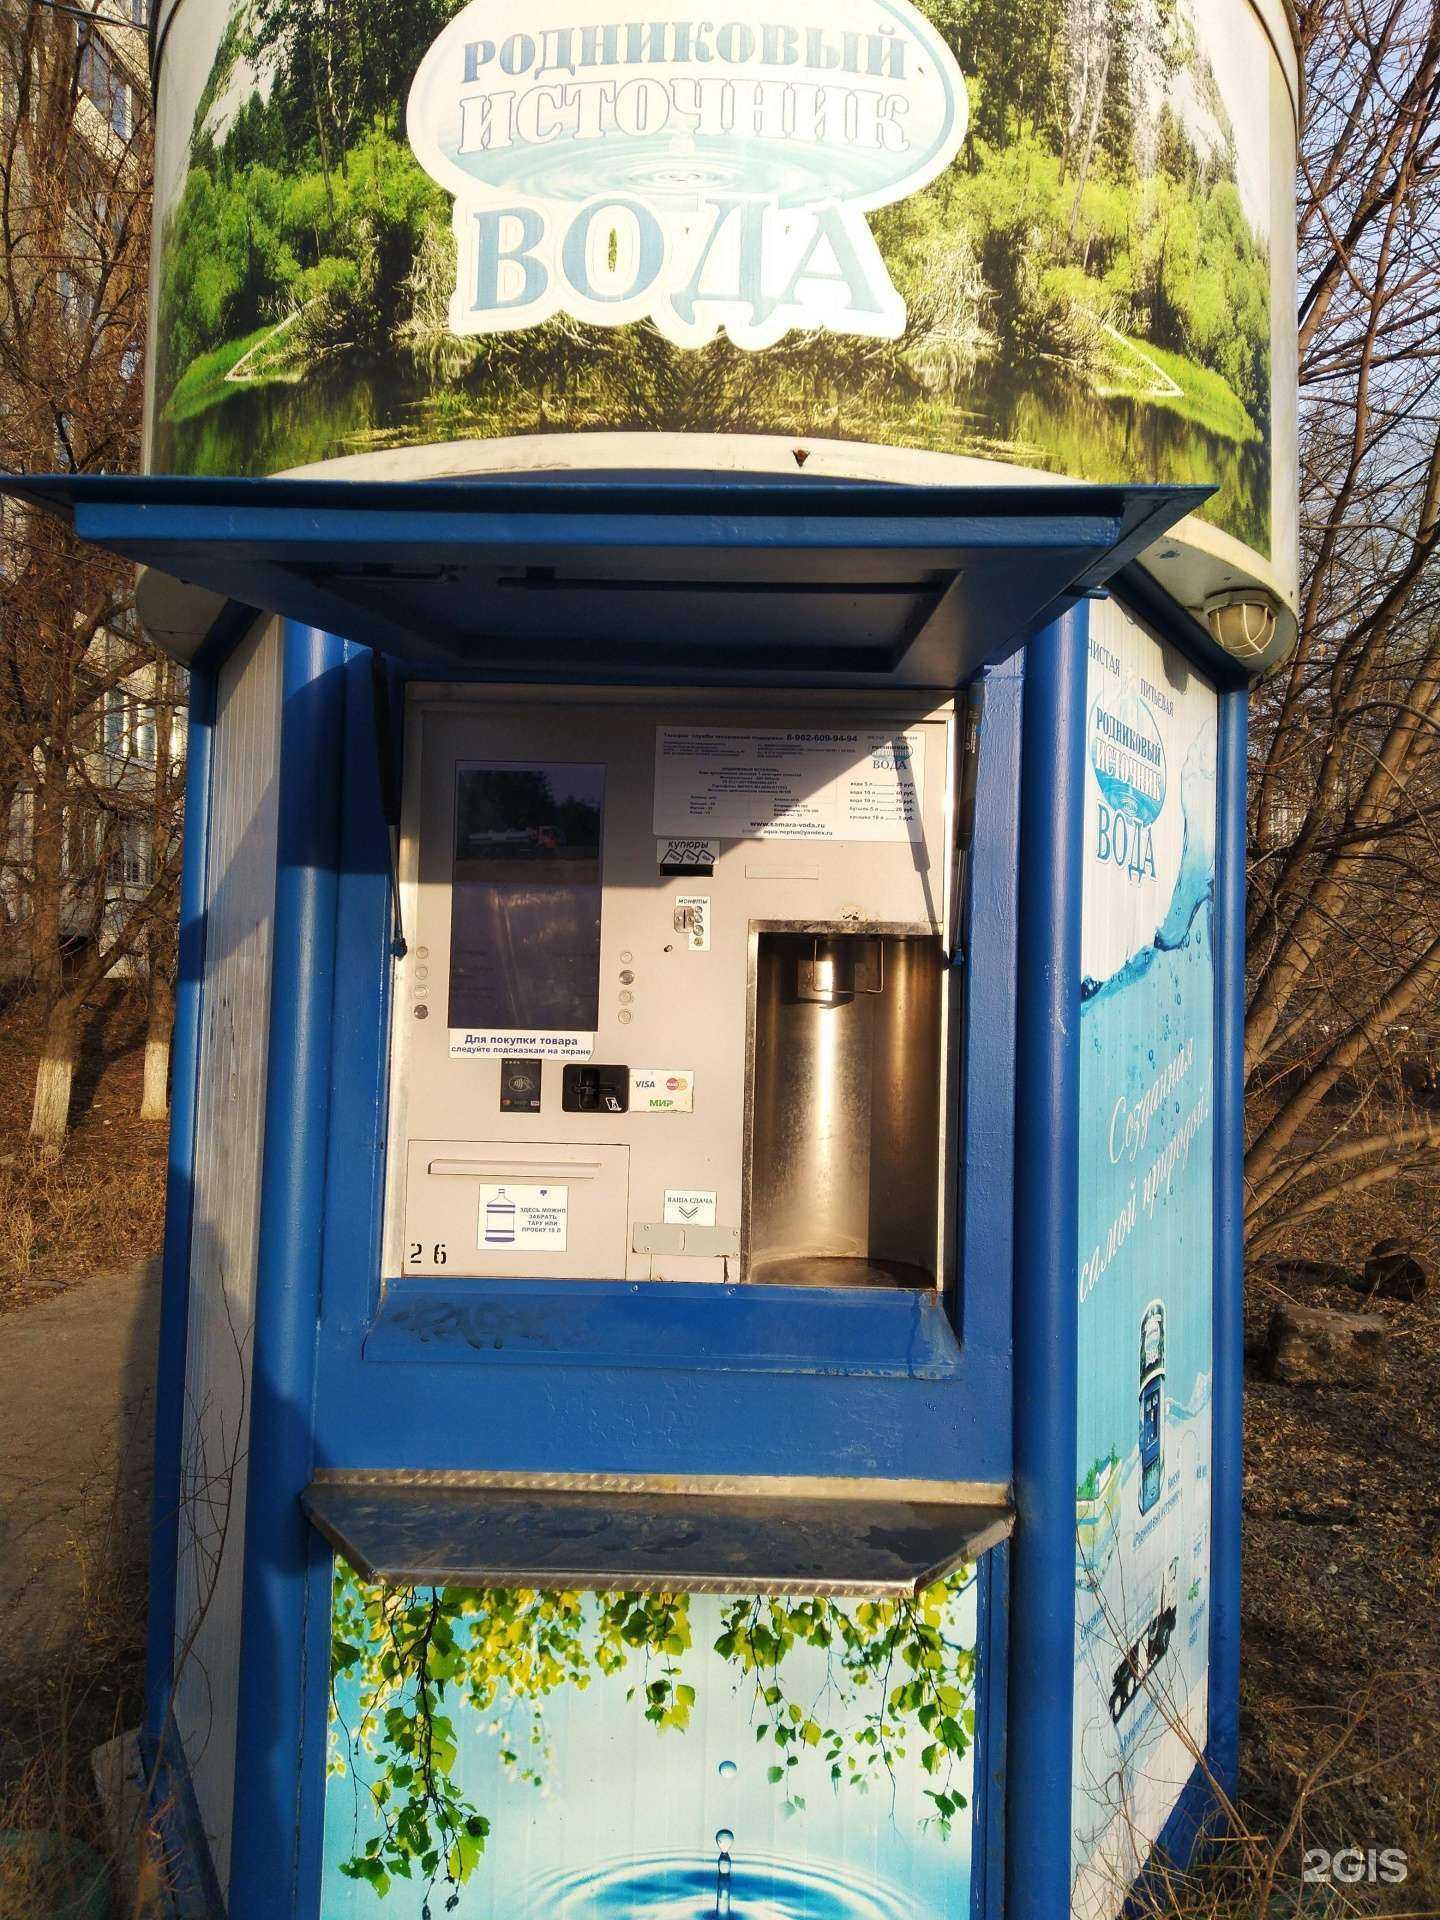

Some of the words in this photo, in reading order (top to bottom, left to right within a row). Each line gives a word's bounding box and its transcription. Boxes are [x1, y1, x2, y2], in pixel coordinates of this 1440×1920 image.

[461, 22, 908, 84] РОДНИКОВЫЙ
[458, 77, 911, 155] ИСТОЧНИК
[470, 200, 884, 326] ВОДА
[1096, 706, 1161, 768] РОДНИКОВЫЙ
[1095, 738, 1161, 801] ИСТОЧНИК
[668, 840, 709, 849] купюры
[1097, 803, 1157, 882] ВОДА
[451, 1046, 491, 1054] следуйте
[493, 1047, 545, 1055] подсказкам
[465, 1034, 487, 1044] Для
[490, 1036, 536, 1046] покупки
[540, 1038, 578, 1047] товара
[635, 1080, 655, 1088] VISA
[649, 1099, 674, 1107] МИР
